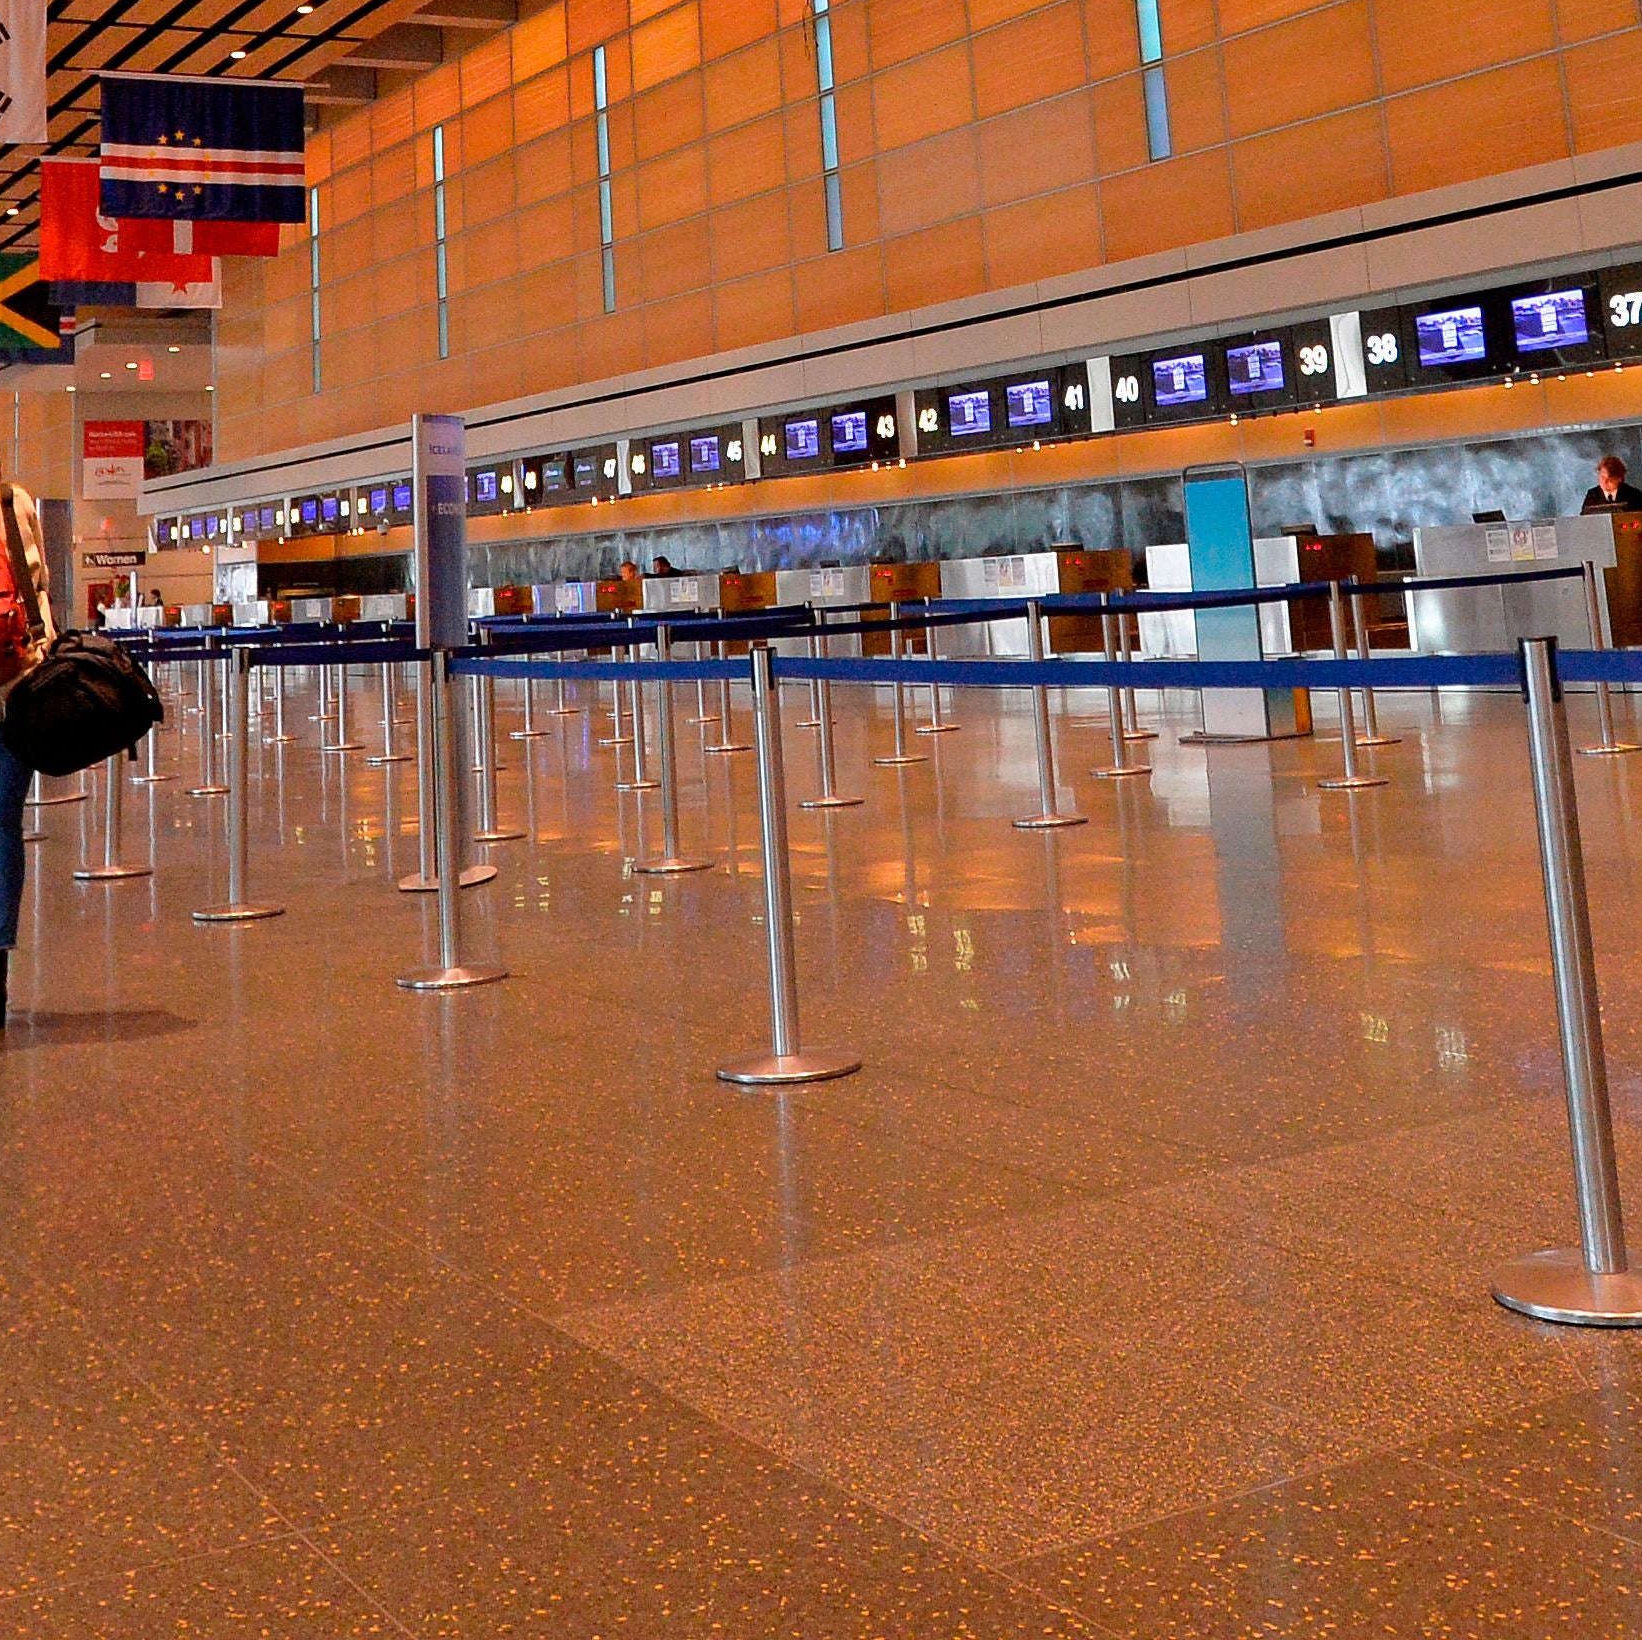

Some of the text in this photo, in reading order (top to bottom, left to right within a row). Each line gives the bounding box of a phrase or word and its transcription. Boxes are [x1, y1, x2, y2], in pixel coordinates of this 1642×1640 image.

[1299, 344, 1329, 375] 39
[1367, 333, 1398, 364] 38
[1064, 384, 1084, 410] 41
[1115, 375, 1139, 403] 40
[876, 415, 896, 439] 43
[918, 408, 939, 433] 42
[726, 440, 743, 462] 45
[760, 434, 777, 457] 44
[95, 554, 137, 566] Women
